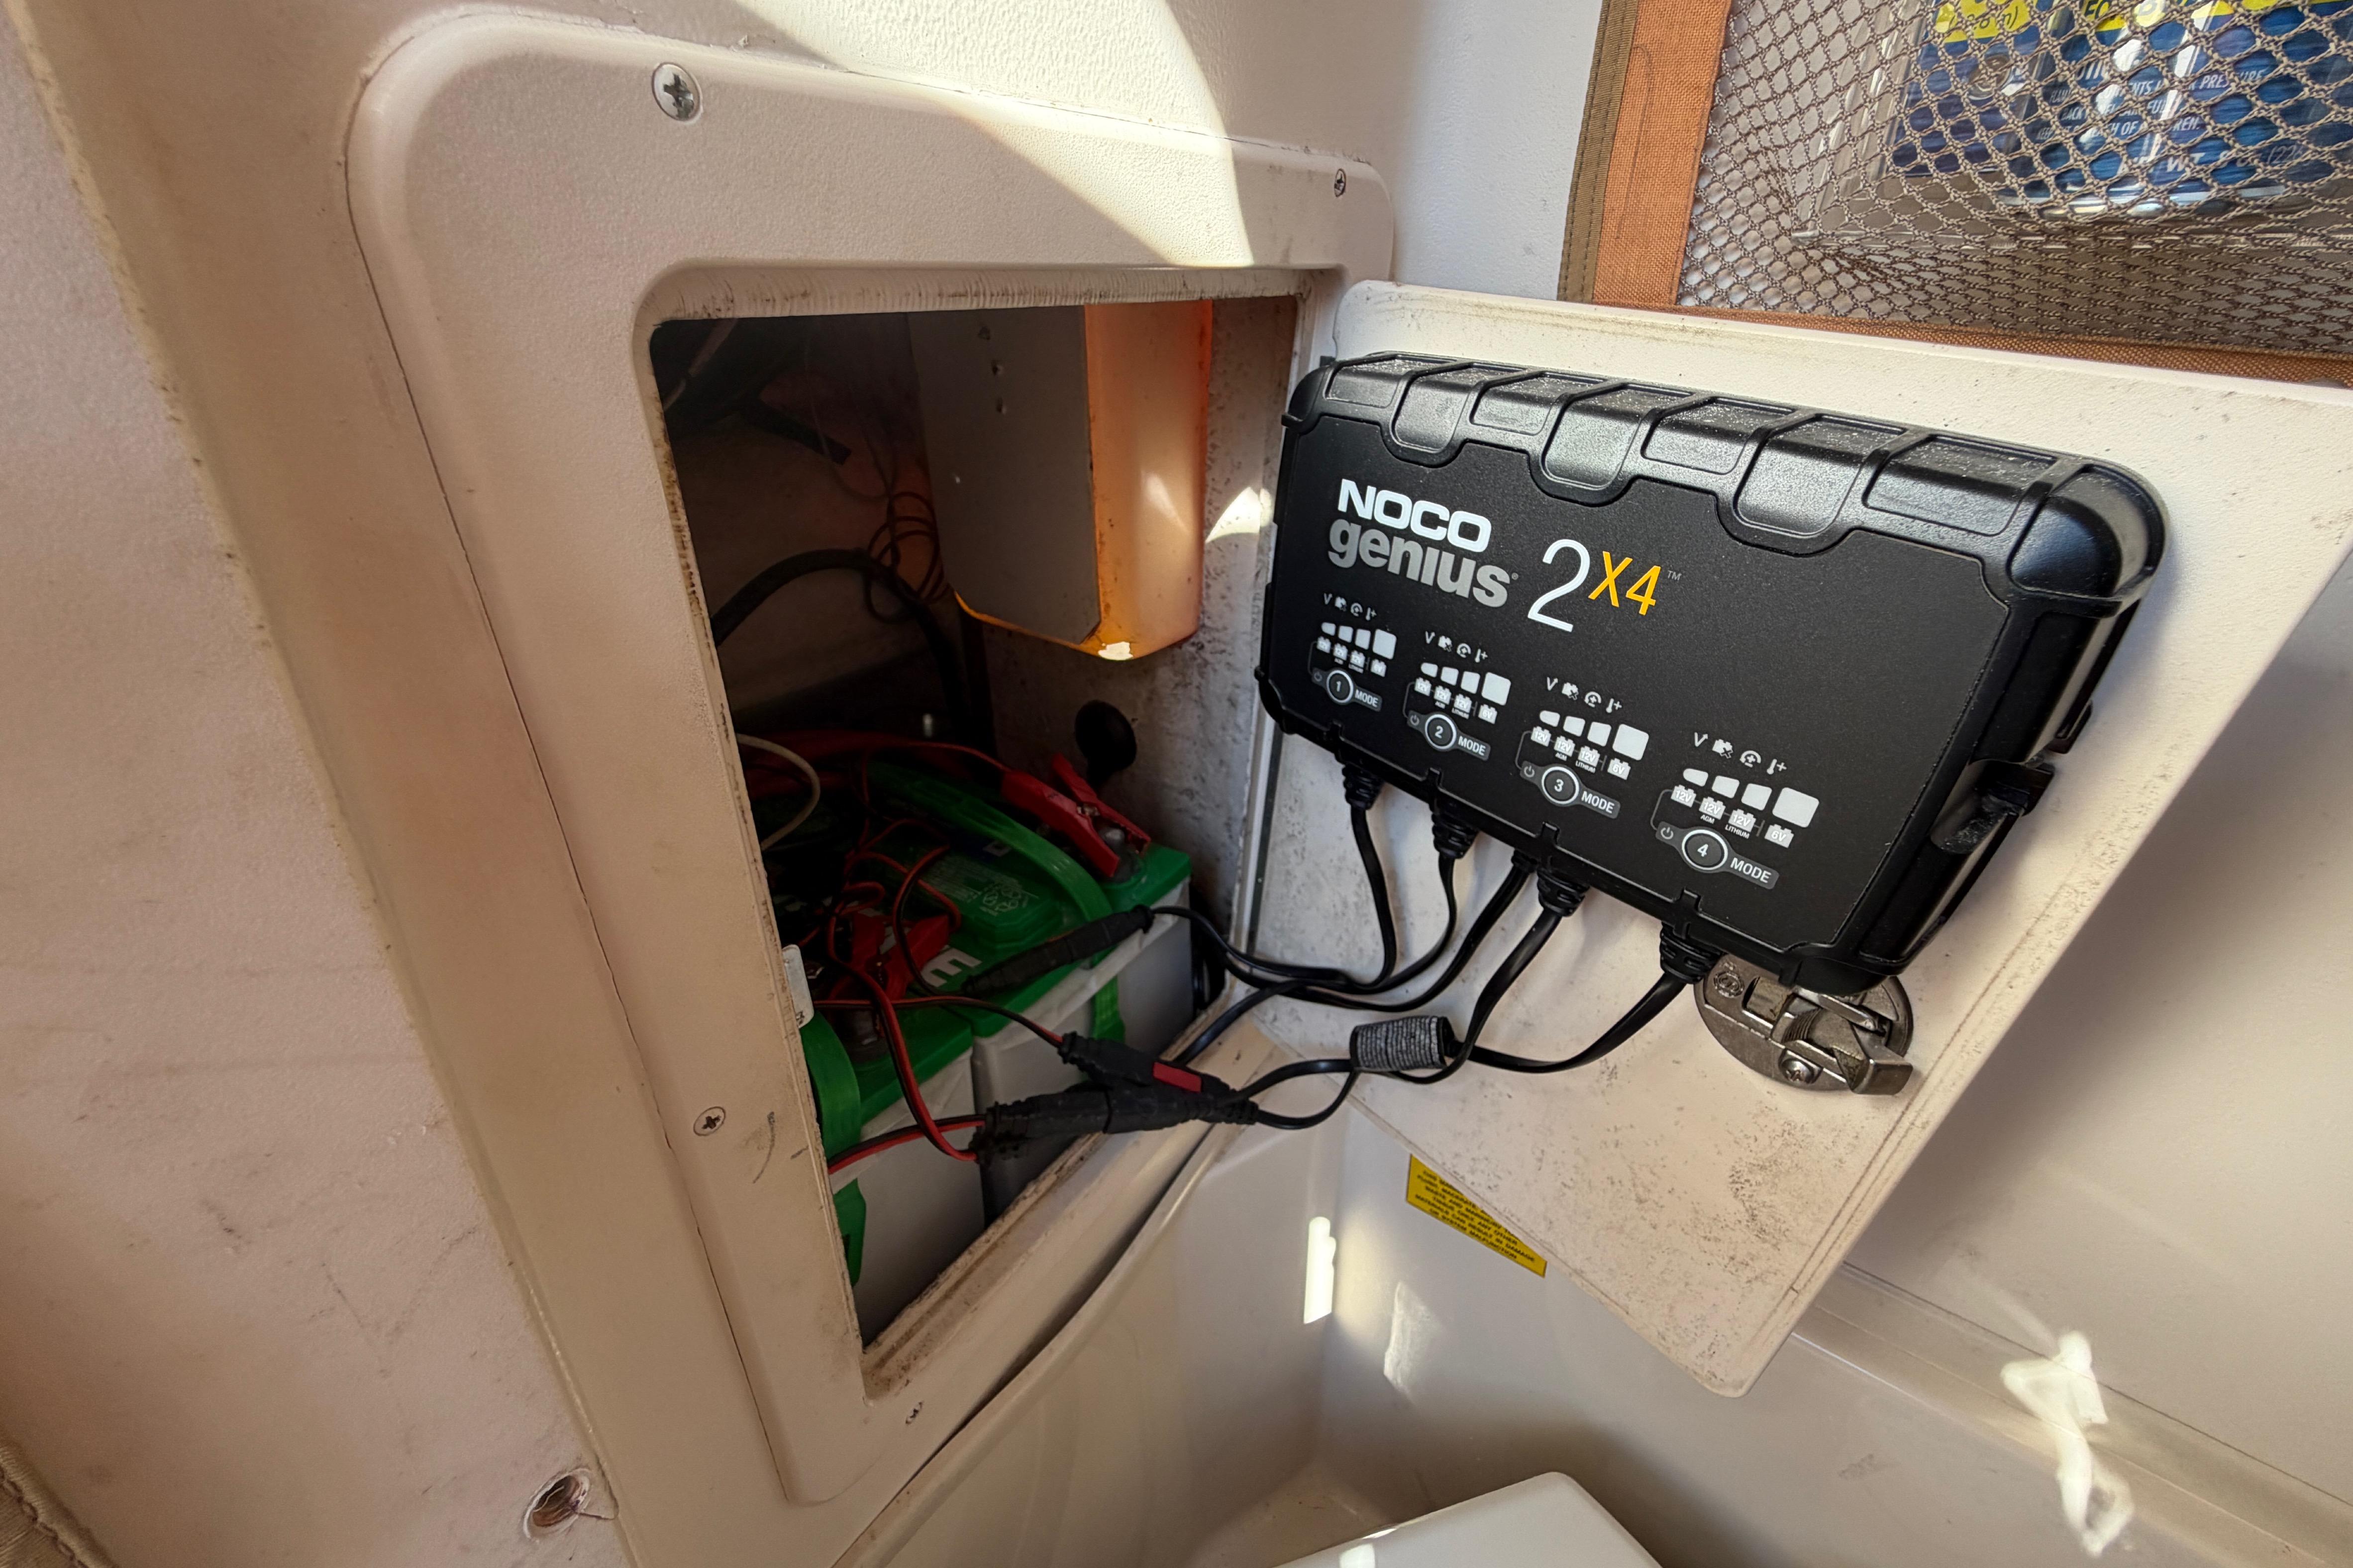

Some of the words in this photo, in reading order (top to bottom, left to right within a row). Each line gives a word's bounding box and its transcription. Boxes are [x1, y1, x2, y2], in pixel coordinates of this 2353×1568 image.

[1338, 478, 1492, 552] NOCO
[1328, 519, 1510, 607] genius
[1335, 680, 1341, 692] 1
[1355, 688, 1378, 707] MODE
[1434, 725, 1443, 739] 2
[1458, 736, 1486, 756] MODE
[1575, 760, 1596, 774] LITHIUM
[1554, 779, 1564, 792] 3
[1581, 790, 1615, 814] MODE
[1700, 814, 1715, 824] AGM
[1725, 824, 1750, 839] LITHIUM
[1697, 843, 1709, 858] 4
[1731, 857, 1772, 883] MODE
